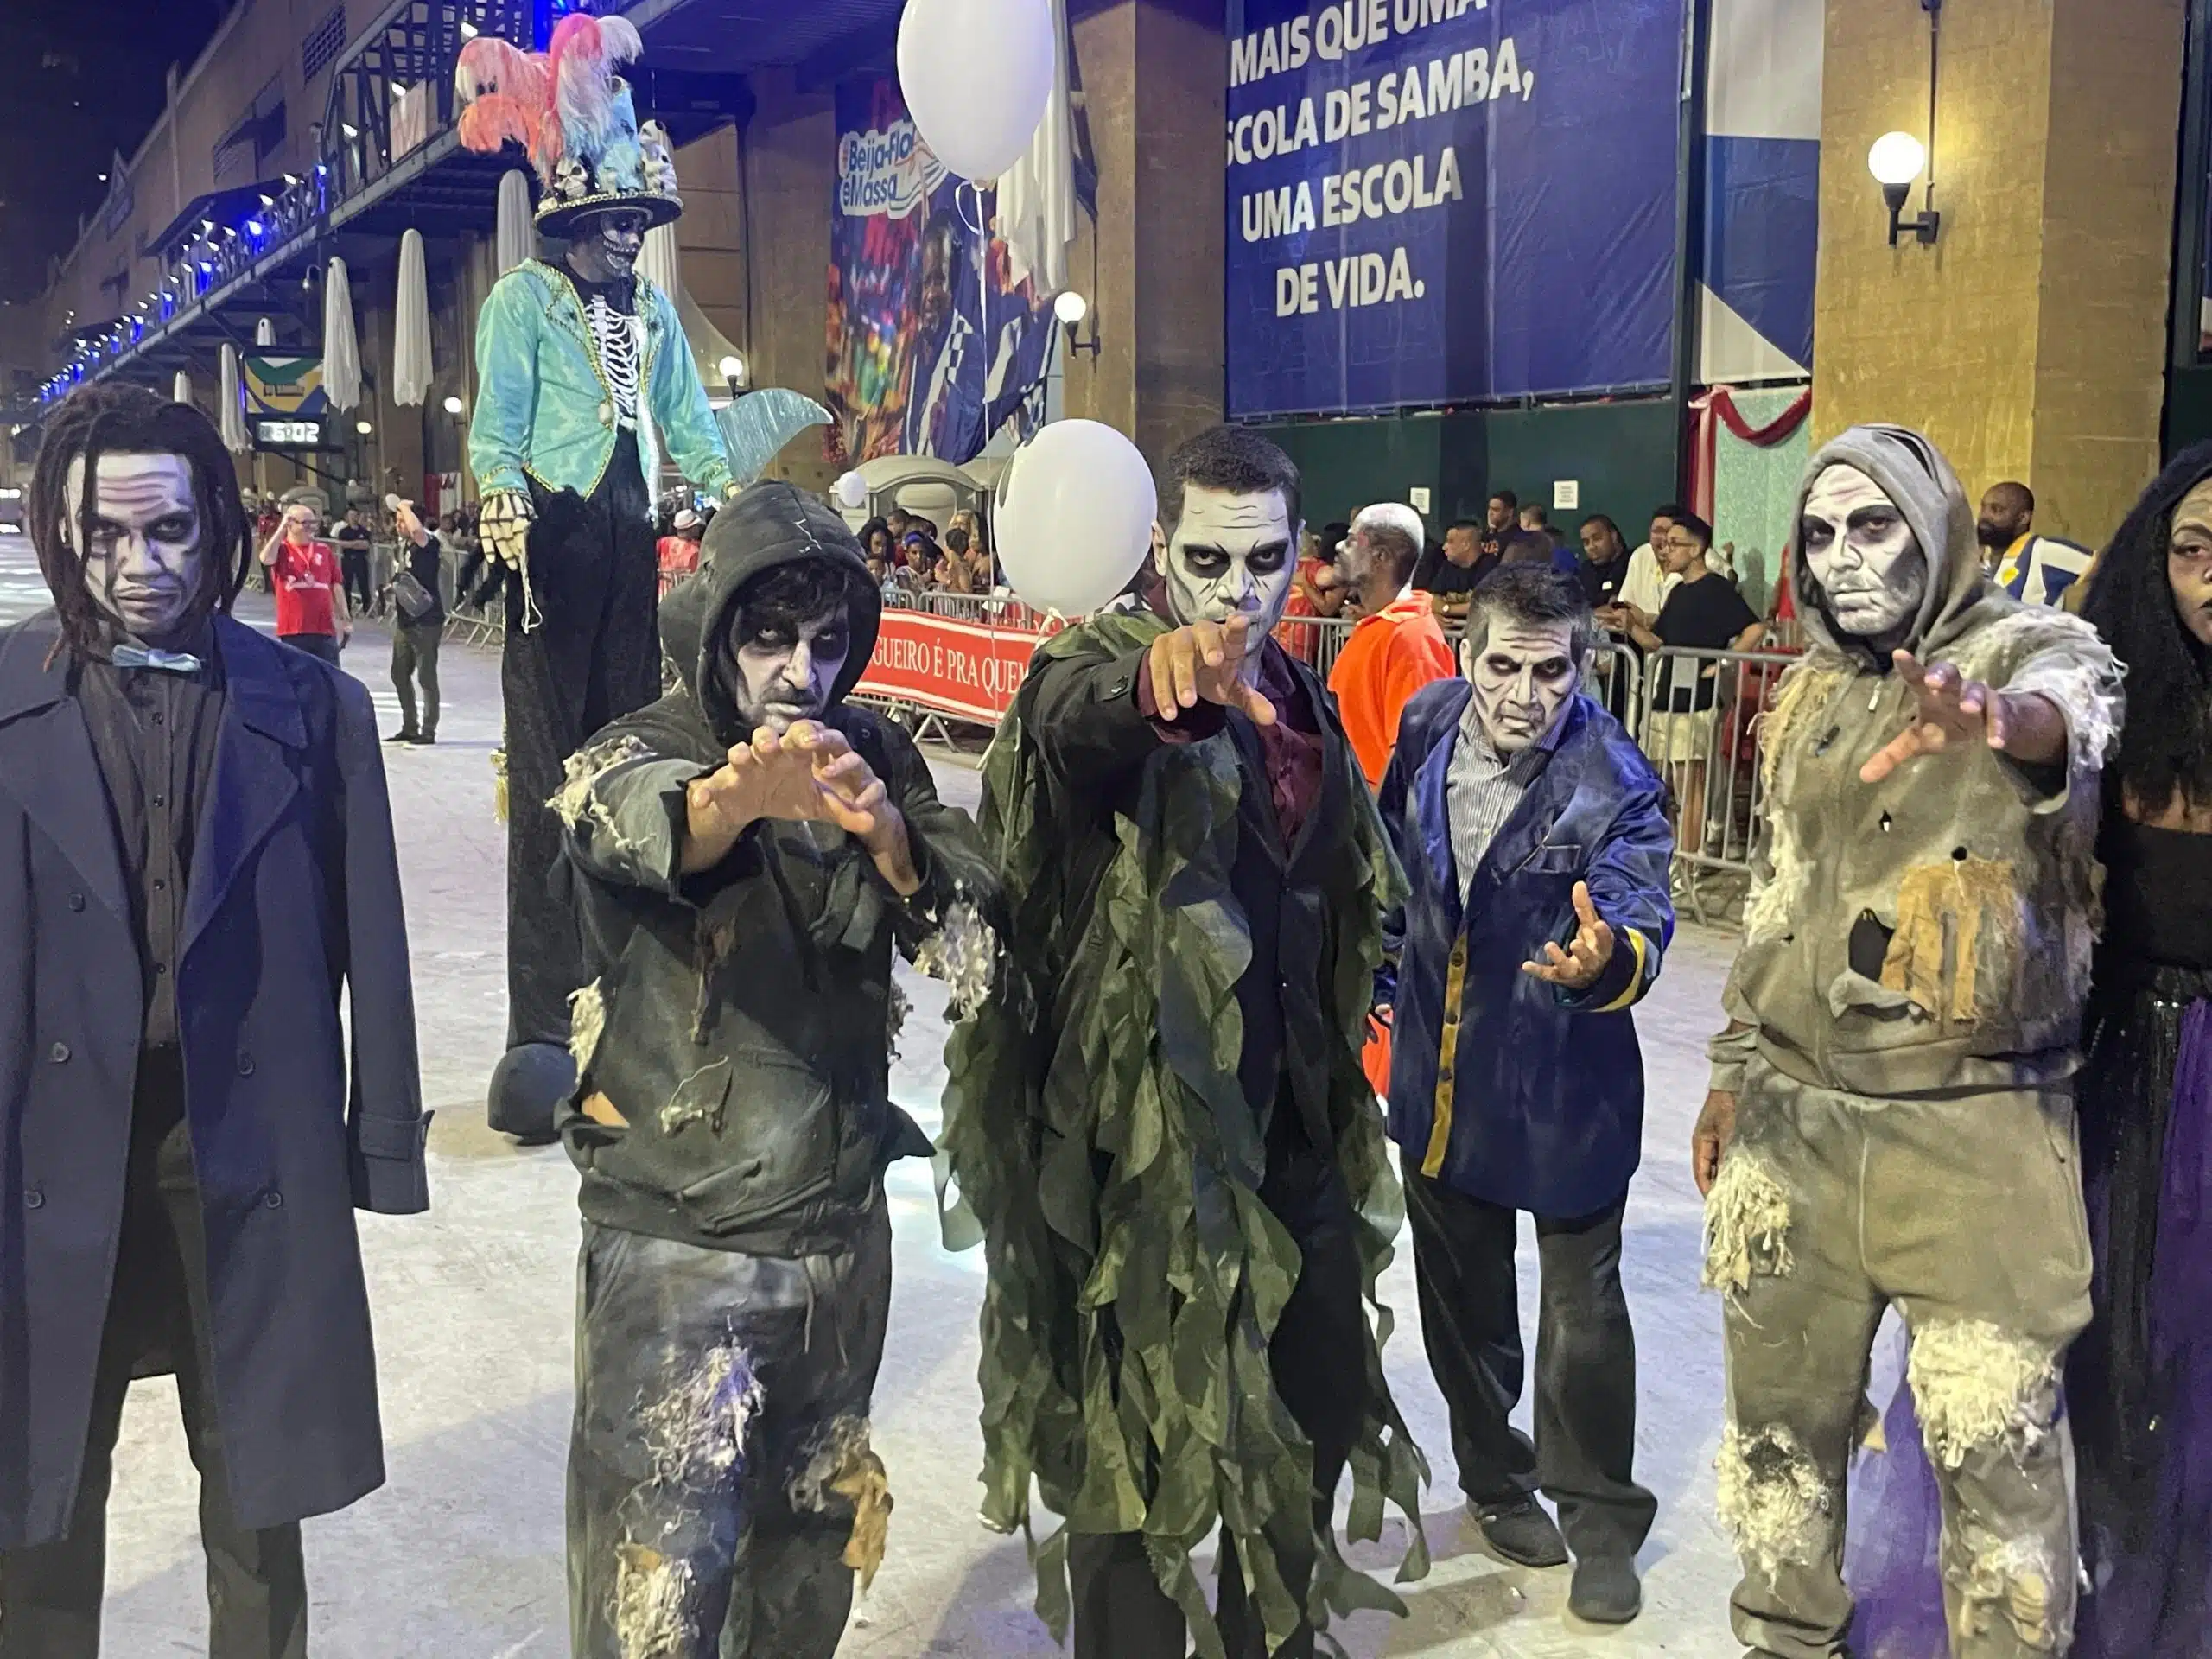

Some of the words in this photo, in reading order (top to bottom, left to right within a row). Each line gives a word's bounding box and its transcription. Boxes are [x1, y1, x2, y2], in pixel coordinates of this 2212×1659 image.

[1230, 15, 1311, 87] MAIS
[1316, 0, 1388, 60] QUE
[1325, 81, 1370, 143] DE
[1377, 37, 1535, 130] SAMBA,
[1242, 181, 1316, 243] UMA
[1322, 147, 1463, 228] ESCOLA
[1276, 264, 1319, 317] DE
[1325, 247, 1425, 309] VIDA.
[933, 638, 943, 677] É
[947, 648, 978, 688] PRA
